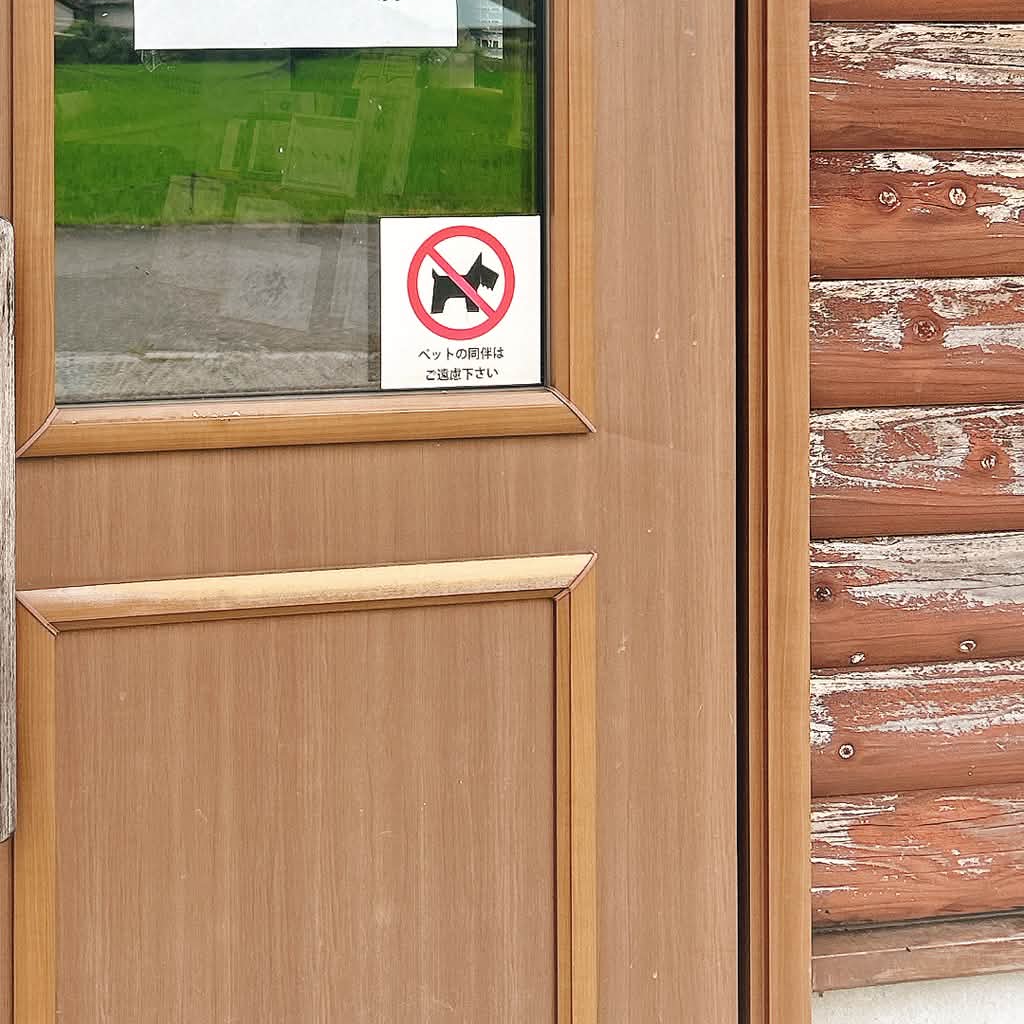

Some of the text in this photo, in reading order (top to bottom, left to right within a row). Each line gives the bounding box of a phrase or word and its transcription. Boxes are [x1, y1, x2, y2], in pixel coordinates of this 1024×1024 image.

[418, 346, 504, 361] ペットの同伴は
[425, 367, 499, 381] ご遠慮下さい
